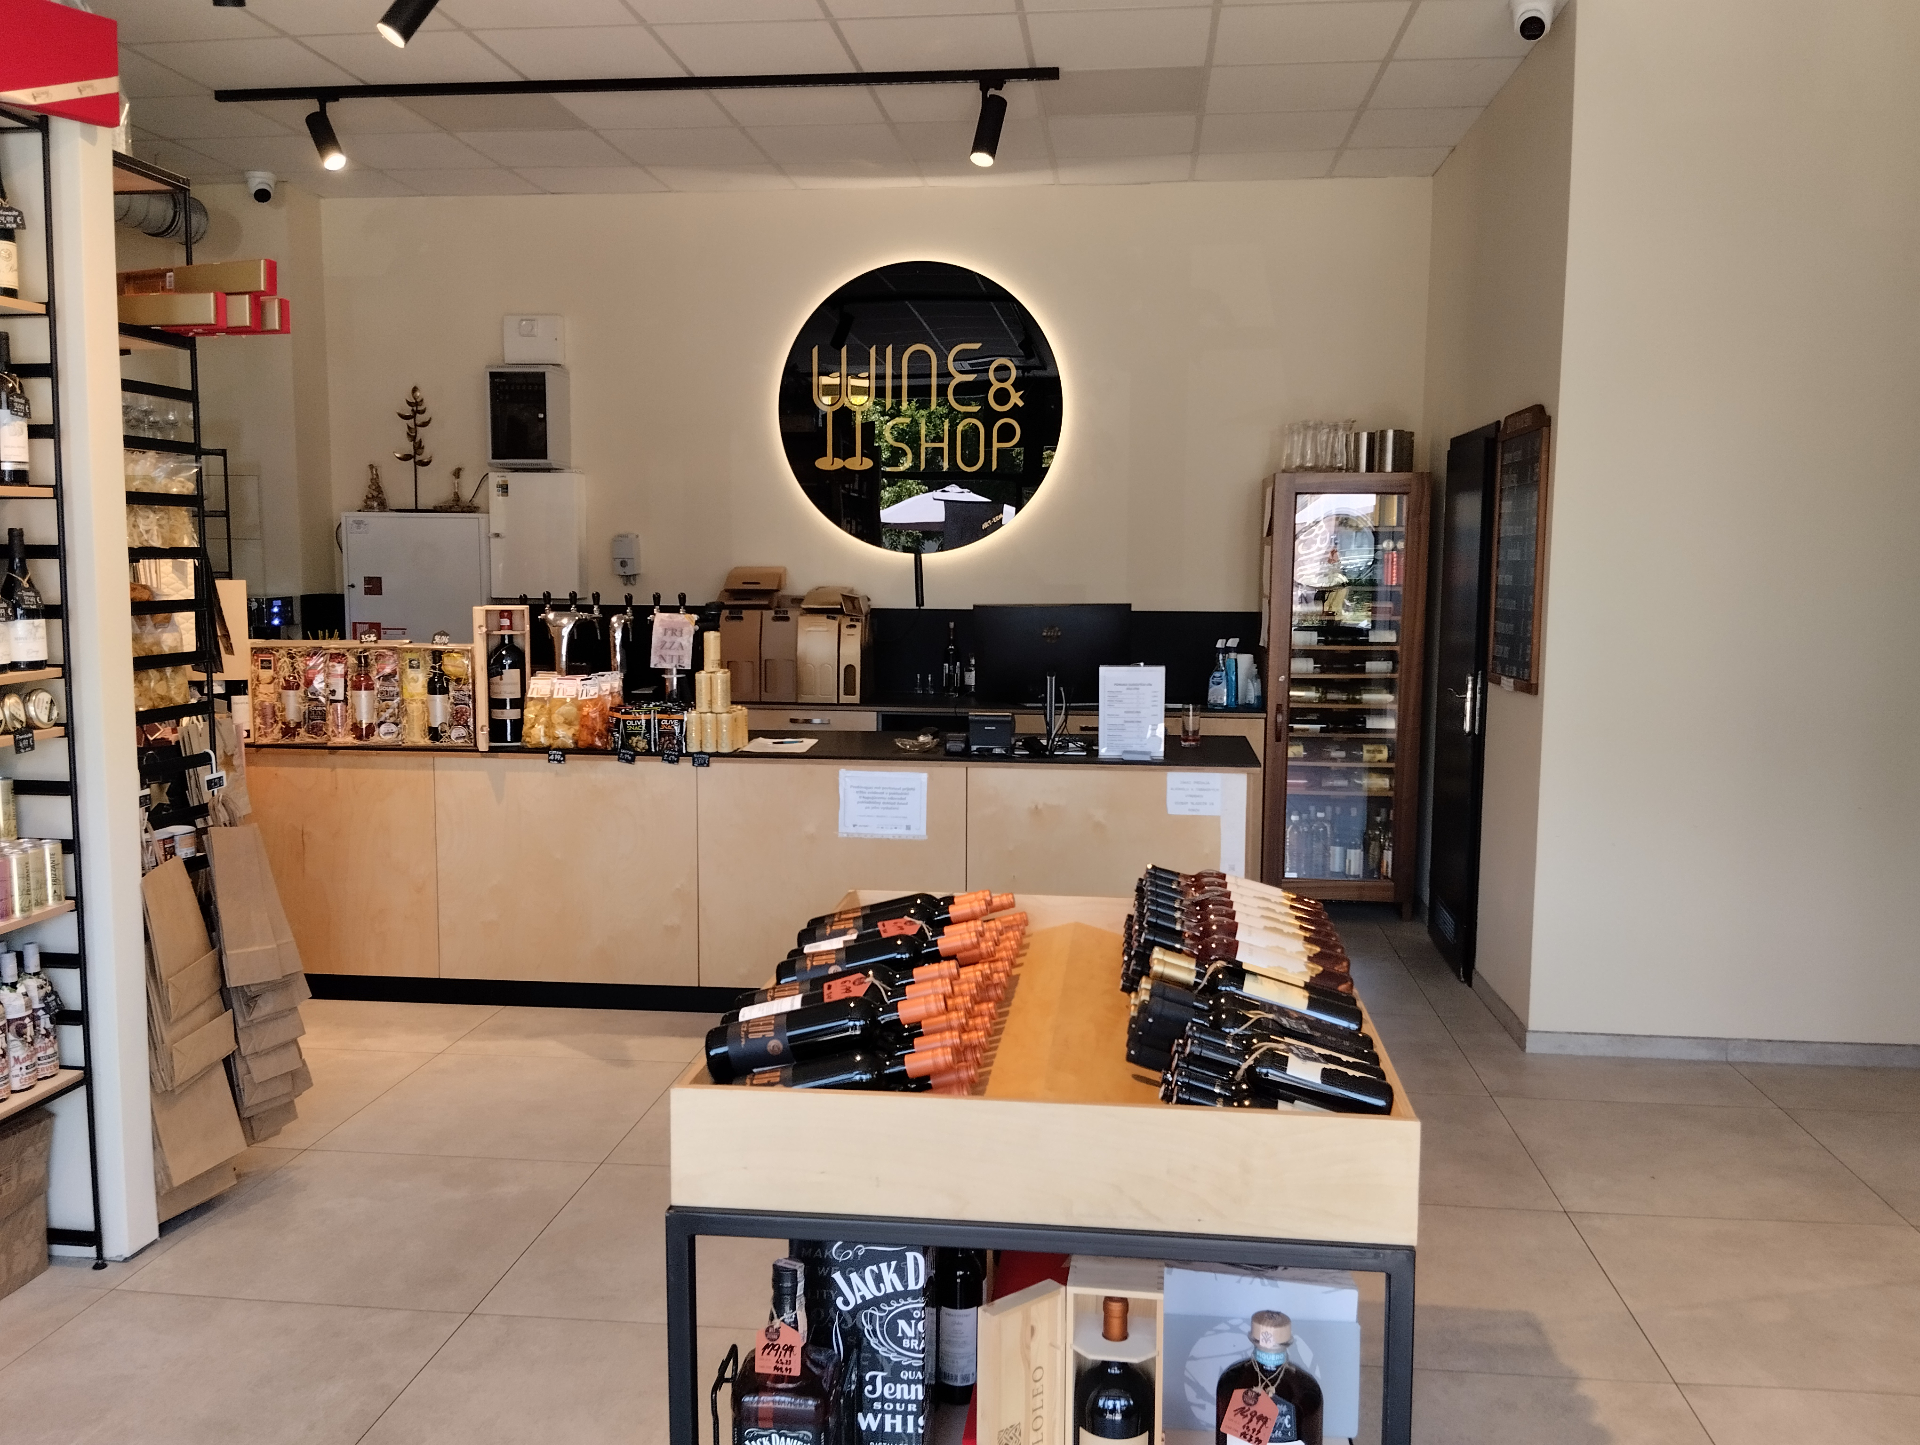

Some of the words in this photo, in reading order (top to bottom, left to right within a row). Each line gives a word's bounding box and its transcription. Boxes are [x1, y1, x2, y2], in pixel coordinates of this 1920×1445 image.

[883, 416, 1022, 473] SHOP
[663, 627, 684, 638] FRI
[660, 640, 685, 651] ZZA
[658, 654, 685, 664] NTE
[831, 1259, 905, 1311] JACK
[873, 1402, 918, 1413] SOUR
